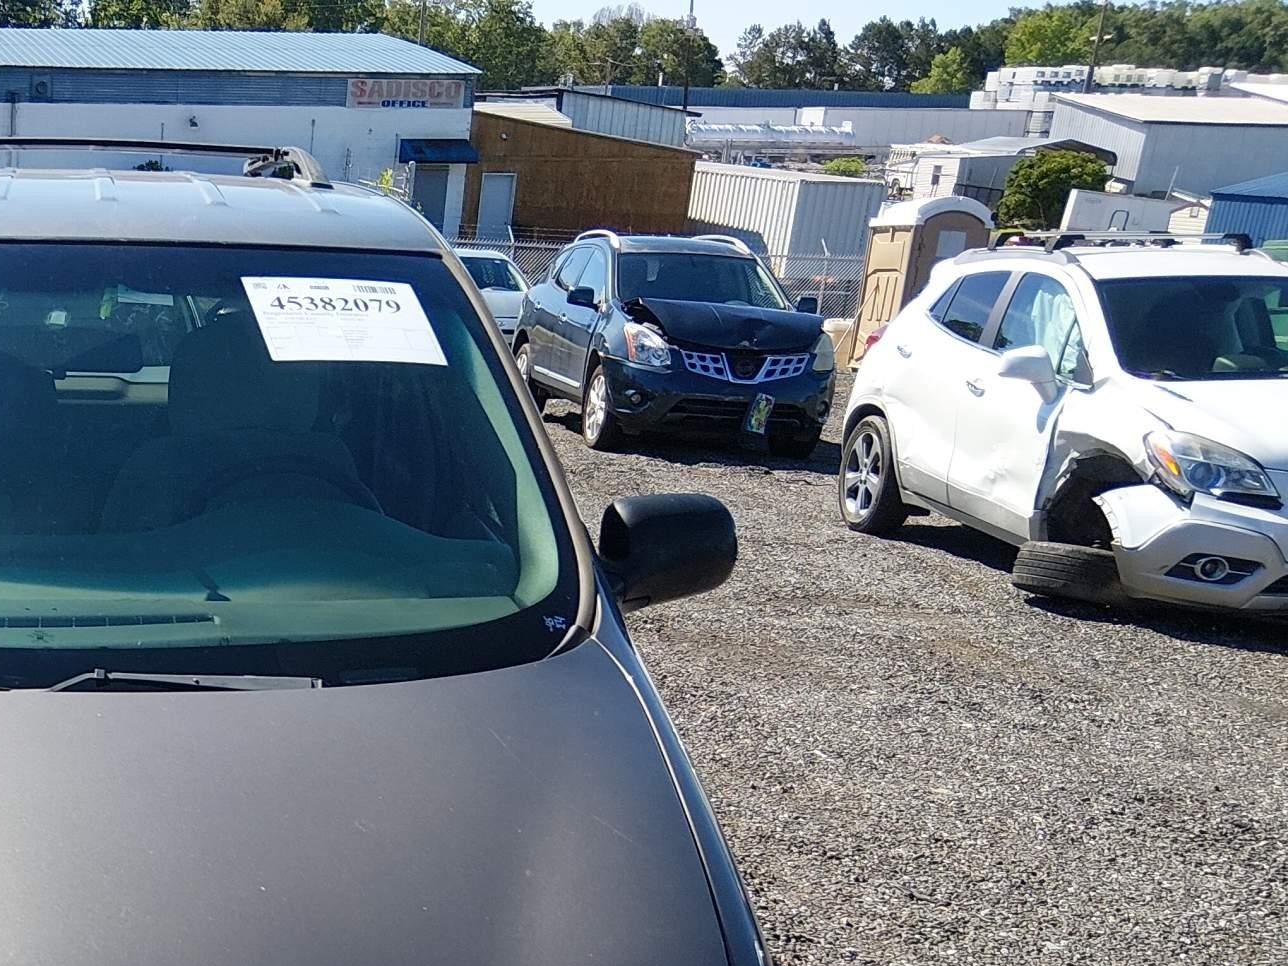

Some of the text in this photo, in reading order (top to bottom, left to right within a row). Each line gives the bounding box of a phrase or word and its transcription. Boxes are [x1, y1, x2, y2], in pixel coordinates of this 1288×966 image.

[350, 80, 462, 98] SADISCO
[380, 99, 429, 108] OFFICE
[270, 296, 402, 314] 45382079
